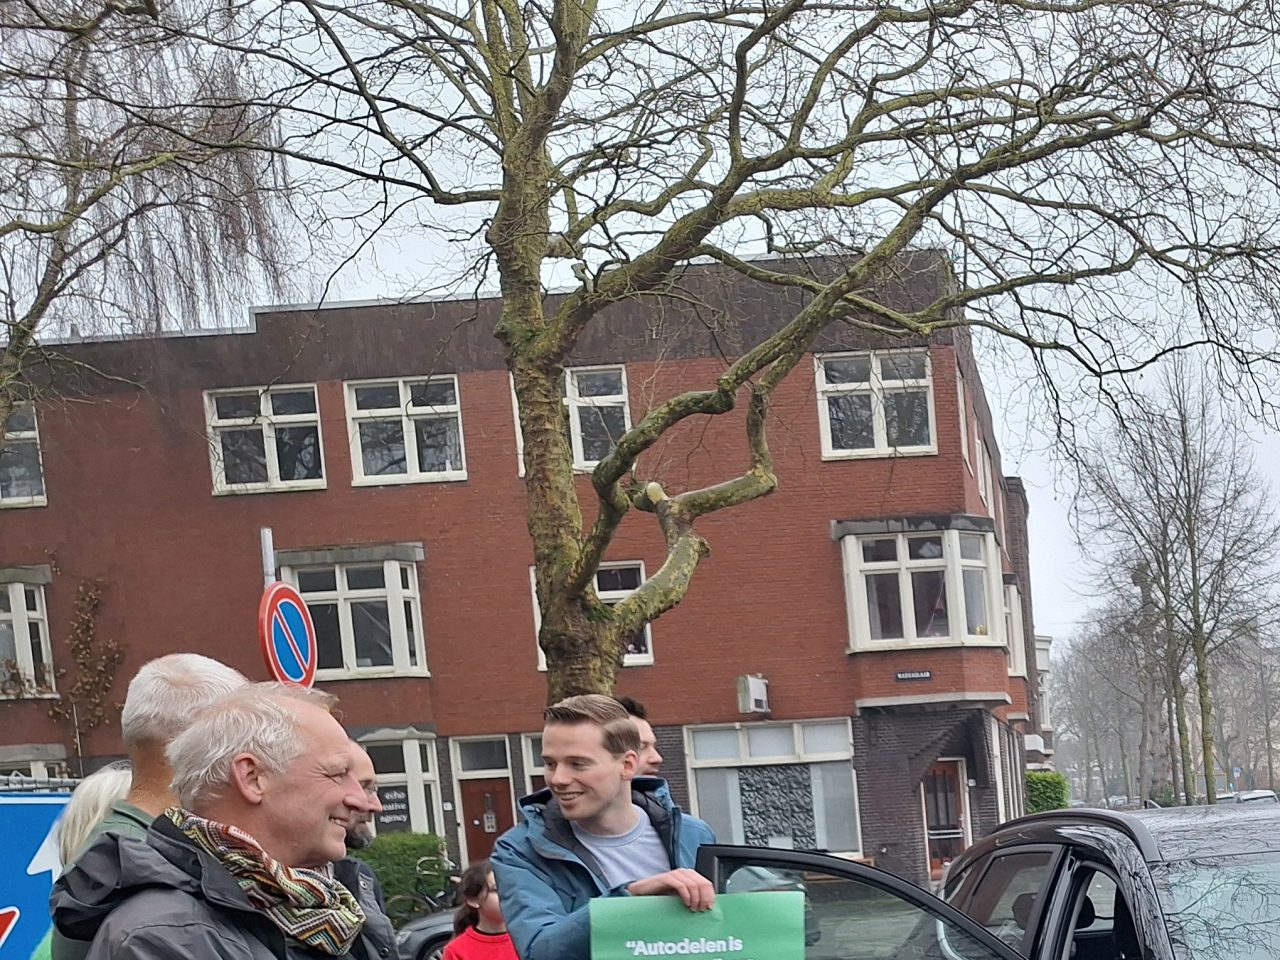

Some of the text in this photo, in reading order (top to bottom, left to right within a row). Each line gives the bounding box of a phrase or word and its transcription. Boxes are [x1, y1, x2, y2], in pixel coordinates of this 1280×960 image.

[385, 791, 405, 799] echo
[383, 803, 406, 811] eative
[379, 814, 407, 823] agency
[728, 936, 744, 952] is
